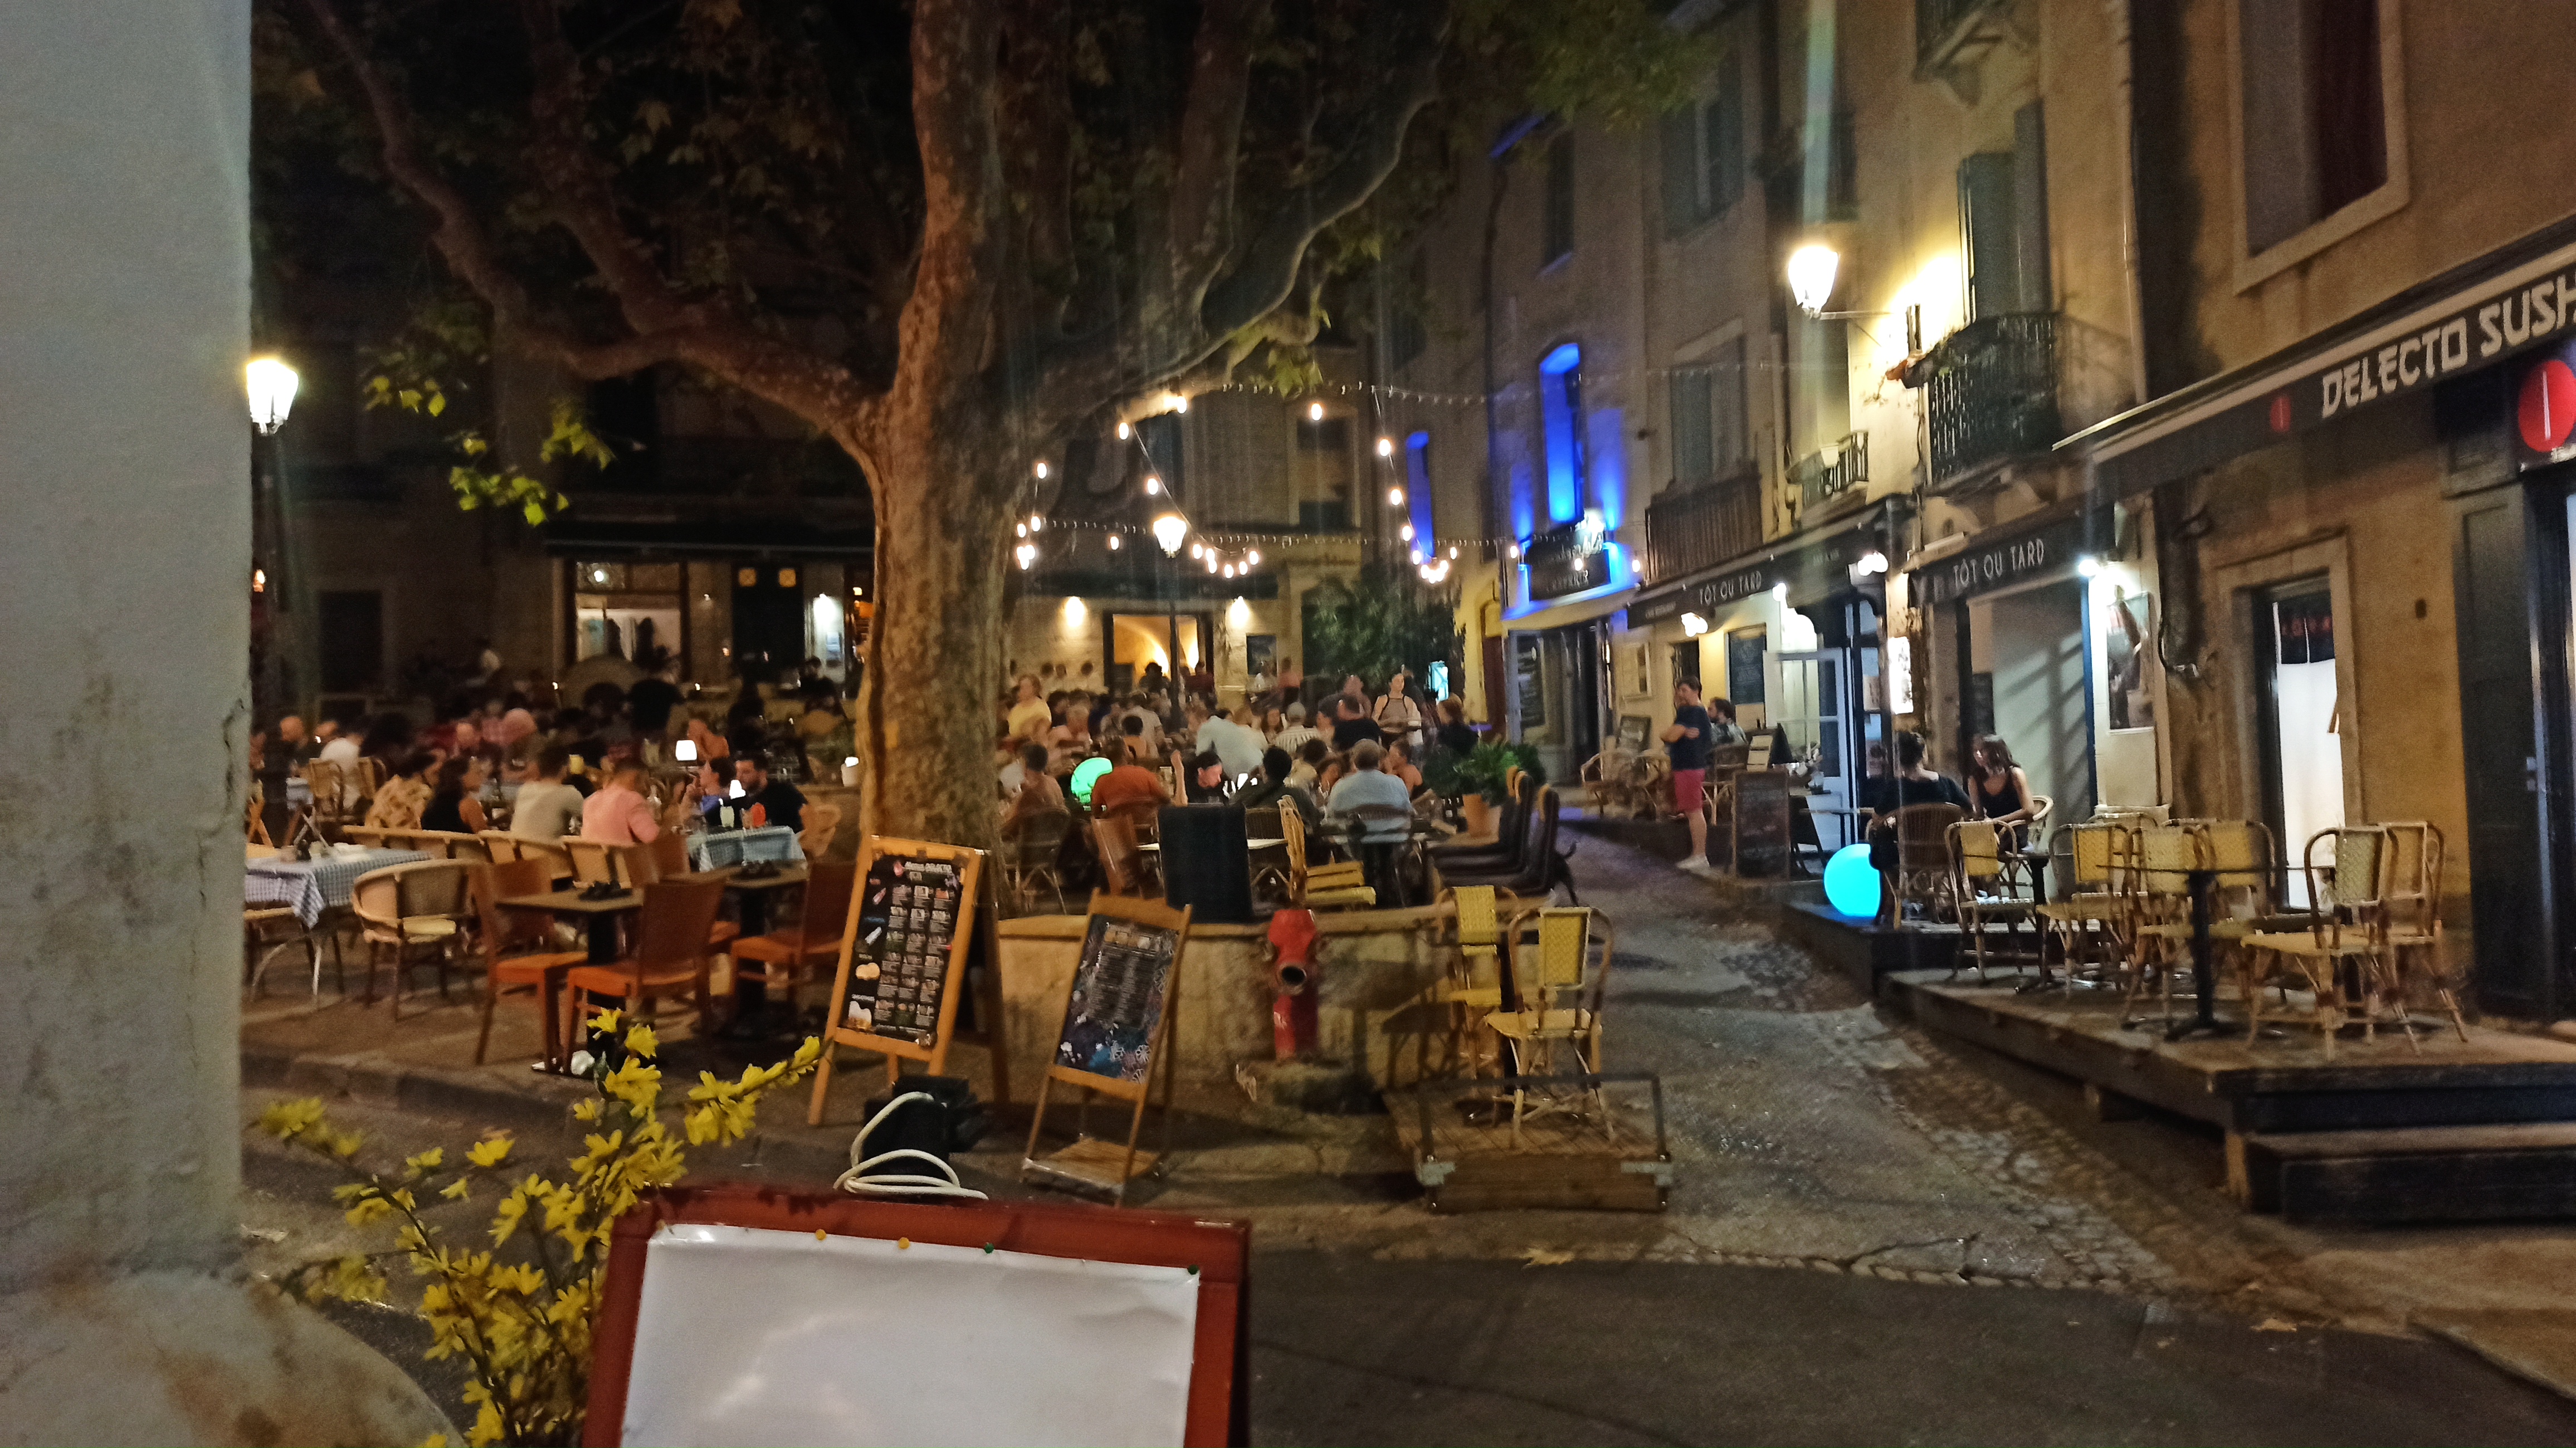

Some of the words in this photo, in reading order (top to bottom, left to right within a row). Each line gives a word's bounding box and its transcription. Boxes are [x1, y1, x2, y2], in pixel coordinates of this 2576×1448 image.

[2322, 316, 2468, 418] DELECTO
[1720, 579, 1735, 601] OU
[1739, 570, 1762, 595] TARD
[1953, 558, 1978, 589] TÔT
[1984, 550, 2003, 580] OU
[2010, 538, 2044, 571] TARD
